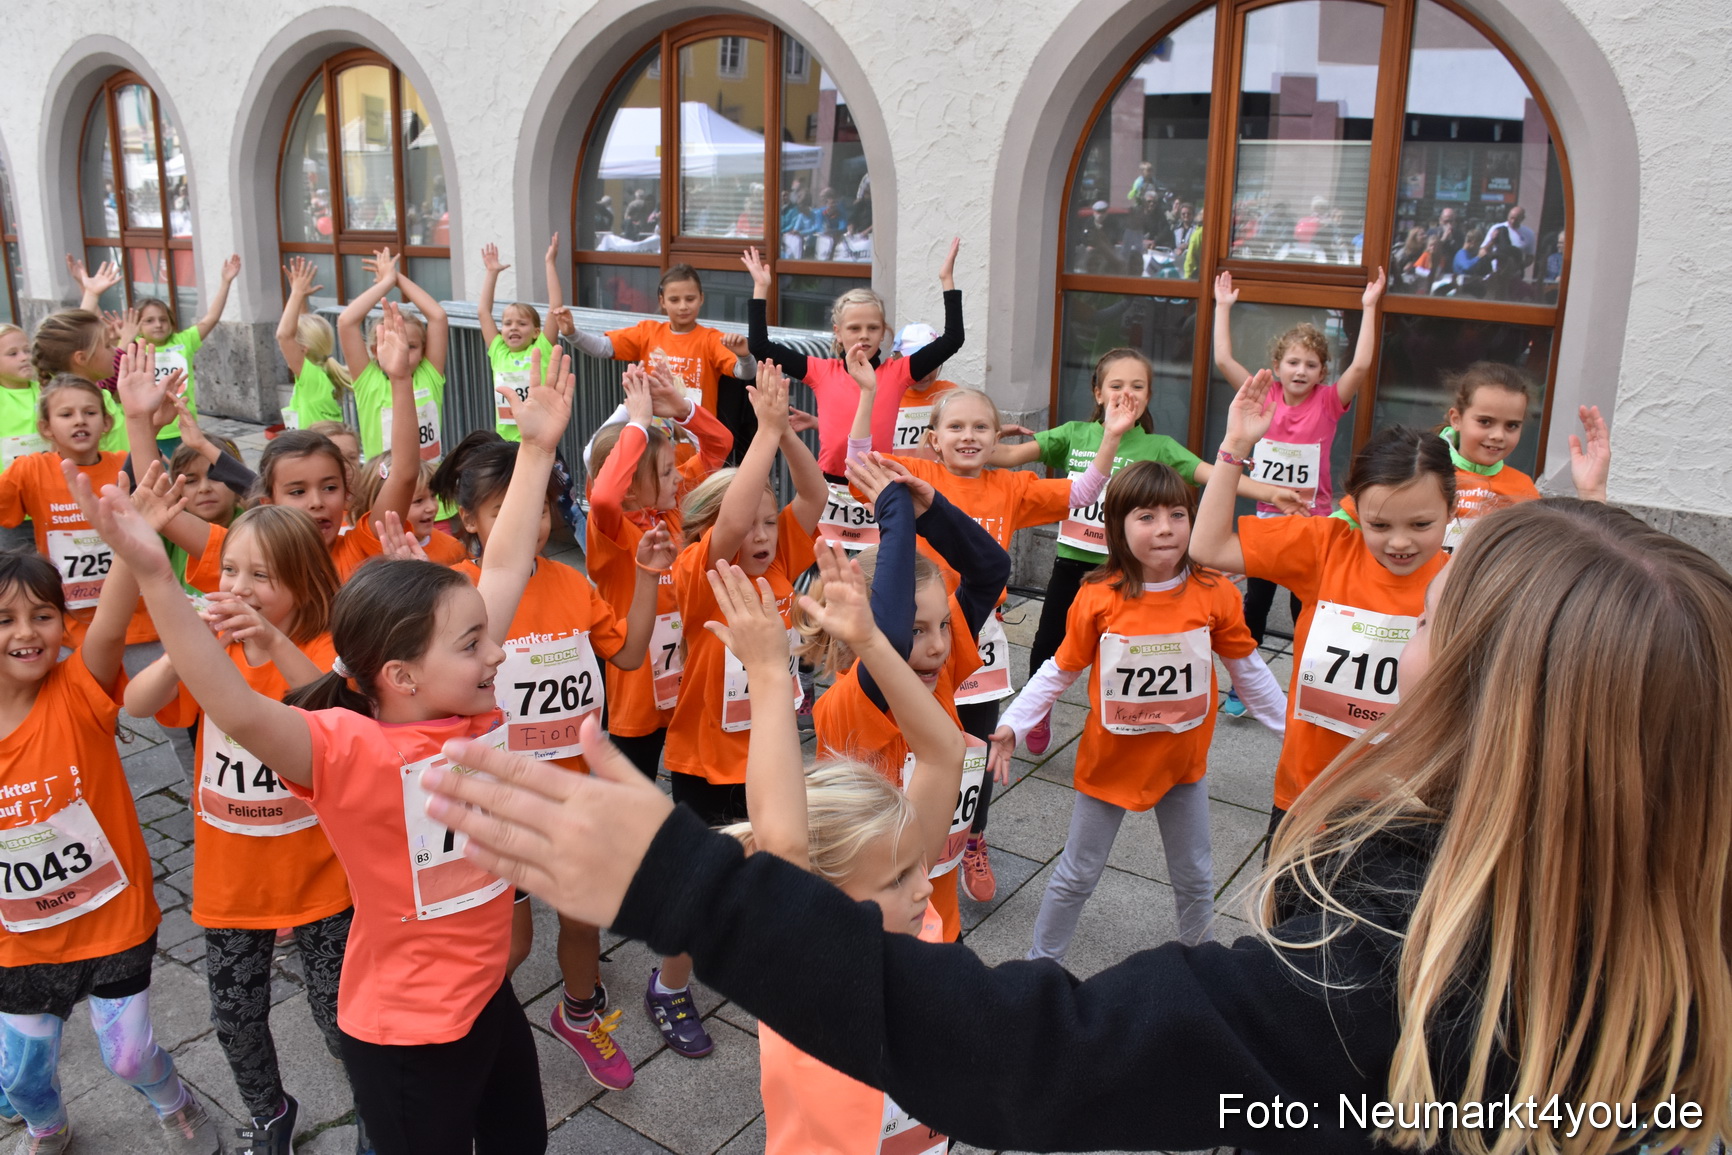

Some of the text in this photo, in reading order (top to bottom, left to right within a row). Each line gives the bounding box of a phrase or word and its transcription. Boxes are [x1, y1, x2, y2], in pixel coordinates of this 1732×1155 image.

[1263, 459, 1308, 484] 7215
[828, 501, 876, 525] 7139
[842, 530, 861, 539] Anne
[1084, 529, 1104, 540] Anna
[64, 552, 113, 578] 725
[1365, 624, 1411, 640] BOCK
[544, 648, 579, 664] BOCK
[1141, 643, 1182, 654] BOCK
[1304, 673, 1314, 682] B3
[1324, 646, 1399, 695] 710
[960, 681, 979, 691] Alise
[1116, 663, 1192, 697] 7221
[514, 671, 594, 716] 7262
[1114, 705, 1162, 721] Kristina
[520, 725, 577, 746] Fion
[228, 803, 283, 818] Felicitas
[6, 829, 58, 850] BOCK
[416, 852, 430, 864] B3
[0, 842, 93, 894] 7043
[36, 889, 77, 911] Marie
